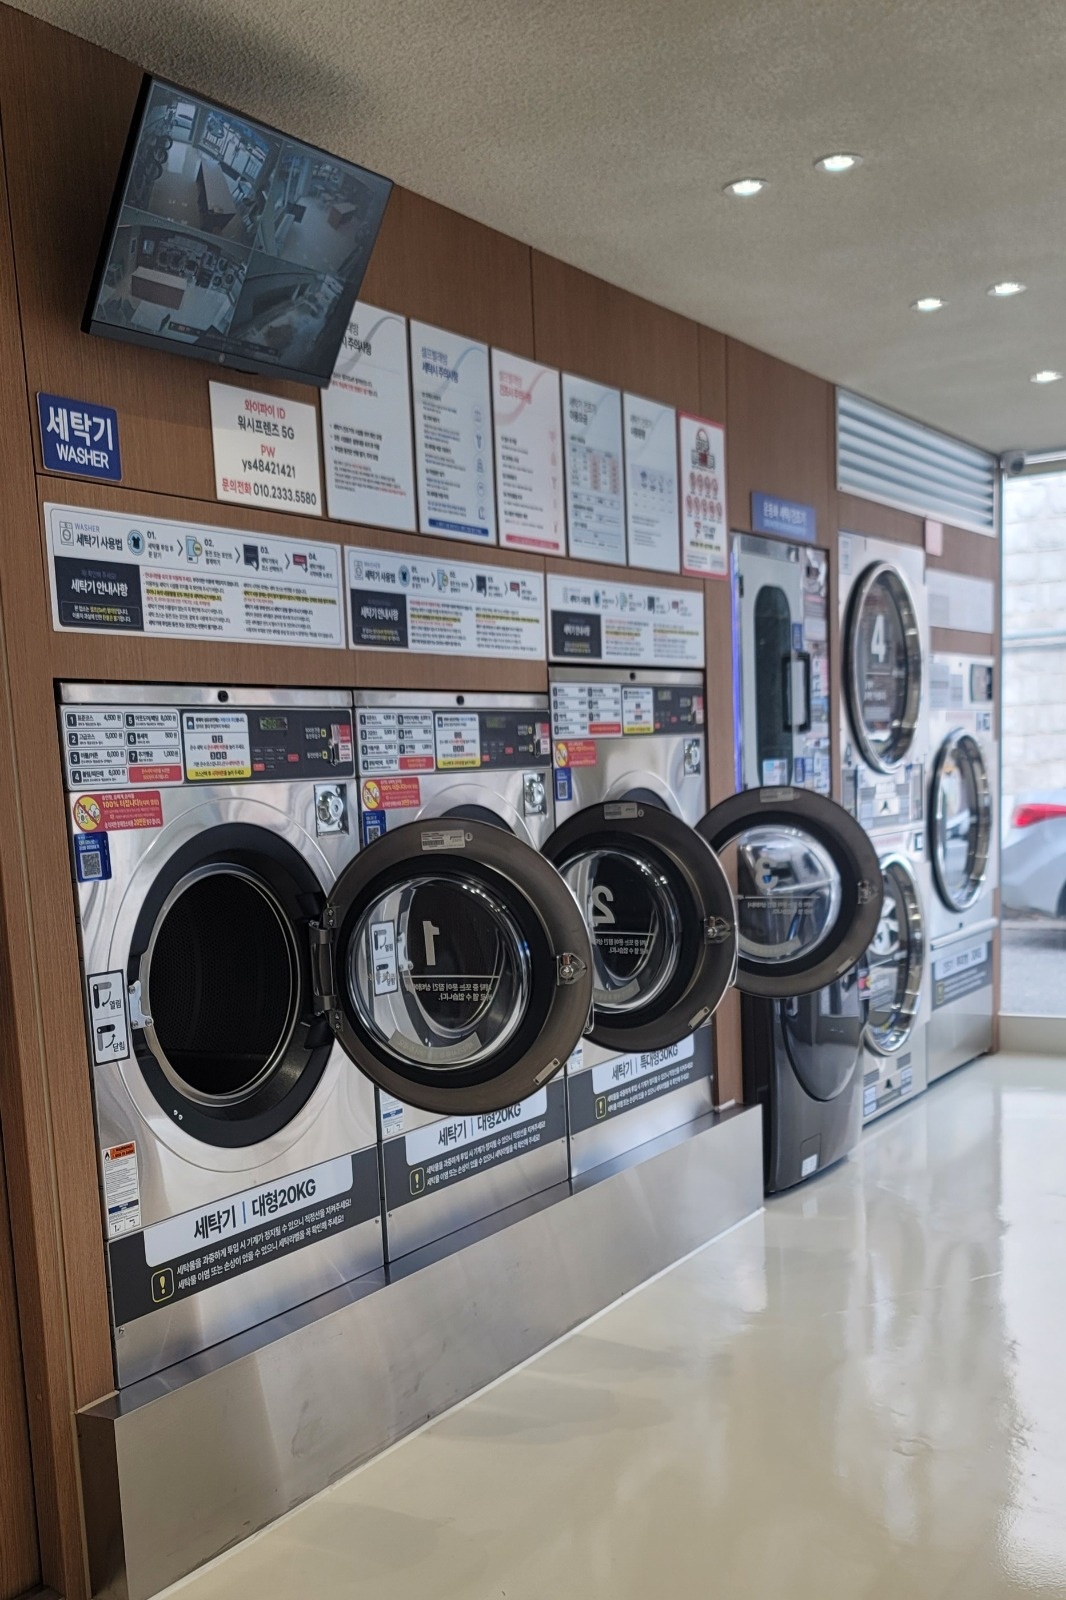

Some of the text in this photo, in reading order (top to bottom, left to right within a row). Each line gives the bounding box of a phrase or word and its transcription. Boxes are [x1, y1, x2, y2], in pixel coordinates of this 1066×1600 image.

[245, 400, 286, 419] 와이파이 ID
[47, 407, 113, 451] 세탁기
[238, 416, 295, 440] 워시프렌즈 5G
[56, 443, 109, 469] WASHER
[261, 445, 275, 458] PW
[242, 459, 296, 478] ys48421421
[222, 478, 316, 505] 문의전화 010.2333.5580
[74, 523, 99, 532] WASHER
[147, 531, 156, 539] 01.
[77, 534, 123, 551] 세탁기 사용법
[205, 539, 214, 547] 02.
[71, 579, 128, 597] 세탁기 안내사항
[871, 615, 886, 663] 4
[70, 716, 74, 725] 1
[109, 999, 122, 1010] 열림
[112, 1041, 126, 1052] 닫힘
[612, 1059, 633, 1080] 세탁기
[438, 1121, 467, 1146] 세탁기
[193, 1178, 316, 1240] 세탁기 대형20KG
[177, 1257, 201, 1275] 세탁물을
[202, 1247, 226, 1265] 과중하게
[227, 1242, 238, 1255] 투입
[240, 1239, 245, 1250] 시
[246, 1232, 263, 1247] 기계가
[264, 1226, 280, 1240] 정지될
[281, 1223, 287, 1233] 수
[287, 1216, 304, 1230] 있으니
[304, 1208, 324, 1223] 적정선을
[178, 1274, 196, 1289] 세탁물
[197, 1268, 209, 1281] 이염
[210, 1264, 222, 1276] 또는
[223, 1256, 241, 1270] 손상이
[242, 1251, 253, 1263] 있을
[254, 1248, 260, 1259] 수
[260, 1241, 277, 1255] 있으니
[305, 1227, 311, 1237] 꼭
[312, 1221, 326, 1234] 확인해
[327, 1214, 344, 1227] 주세요!
